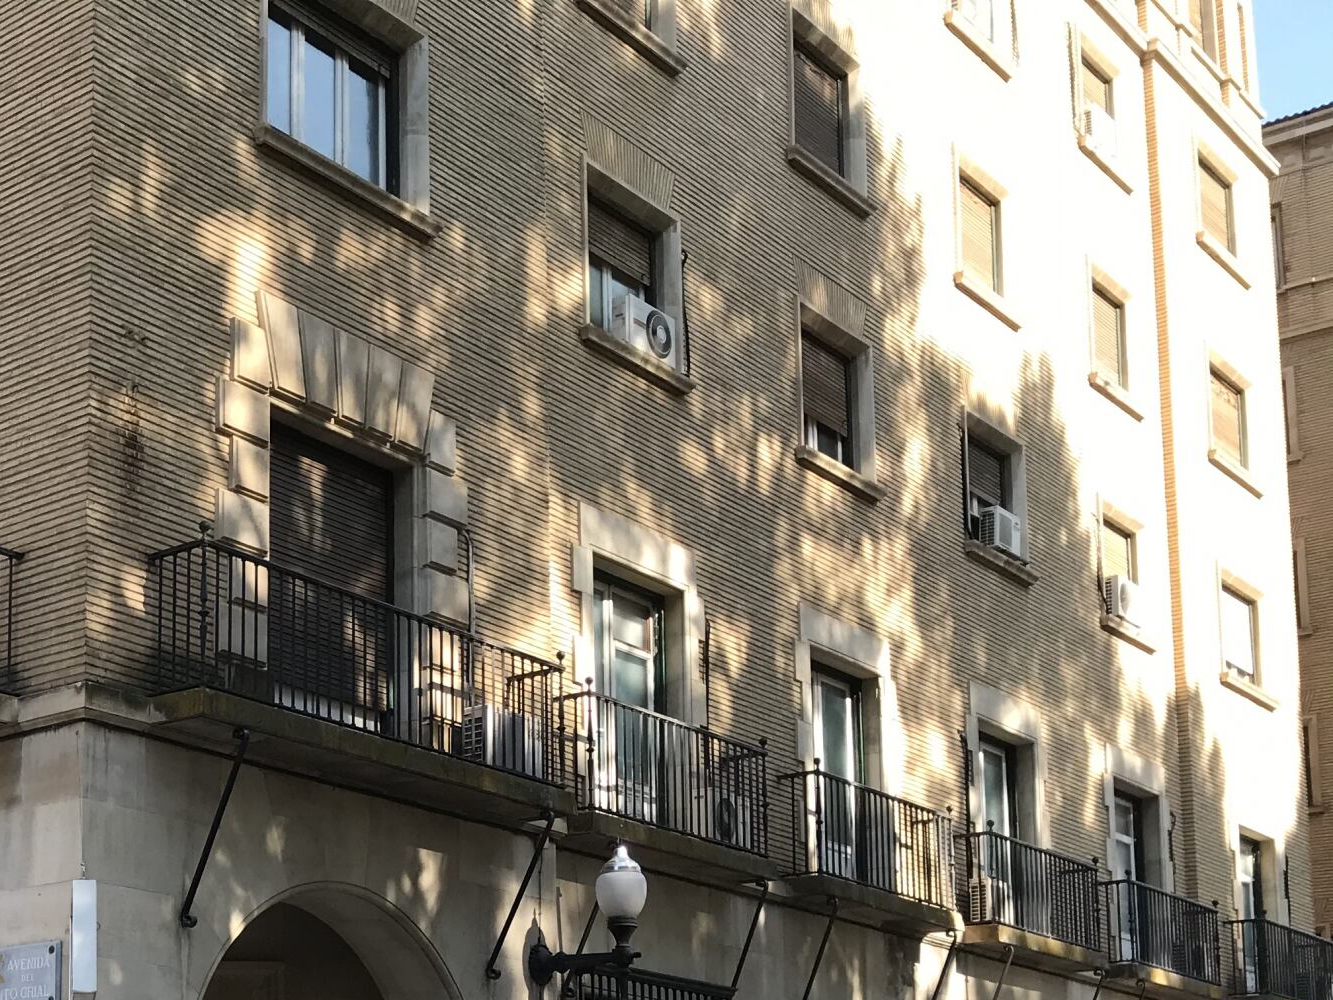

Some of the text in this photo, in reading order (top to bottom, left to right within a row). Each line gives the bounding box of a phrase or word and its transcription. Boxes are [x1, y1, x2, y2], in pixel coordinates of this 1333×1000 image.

[7, 957, 50, 970] AVENIDA
[20, 974, 34, 982] DEL
[20, 984, 50, 998] GRIAL
